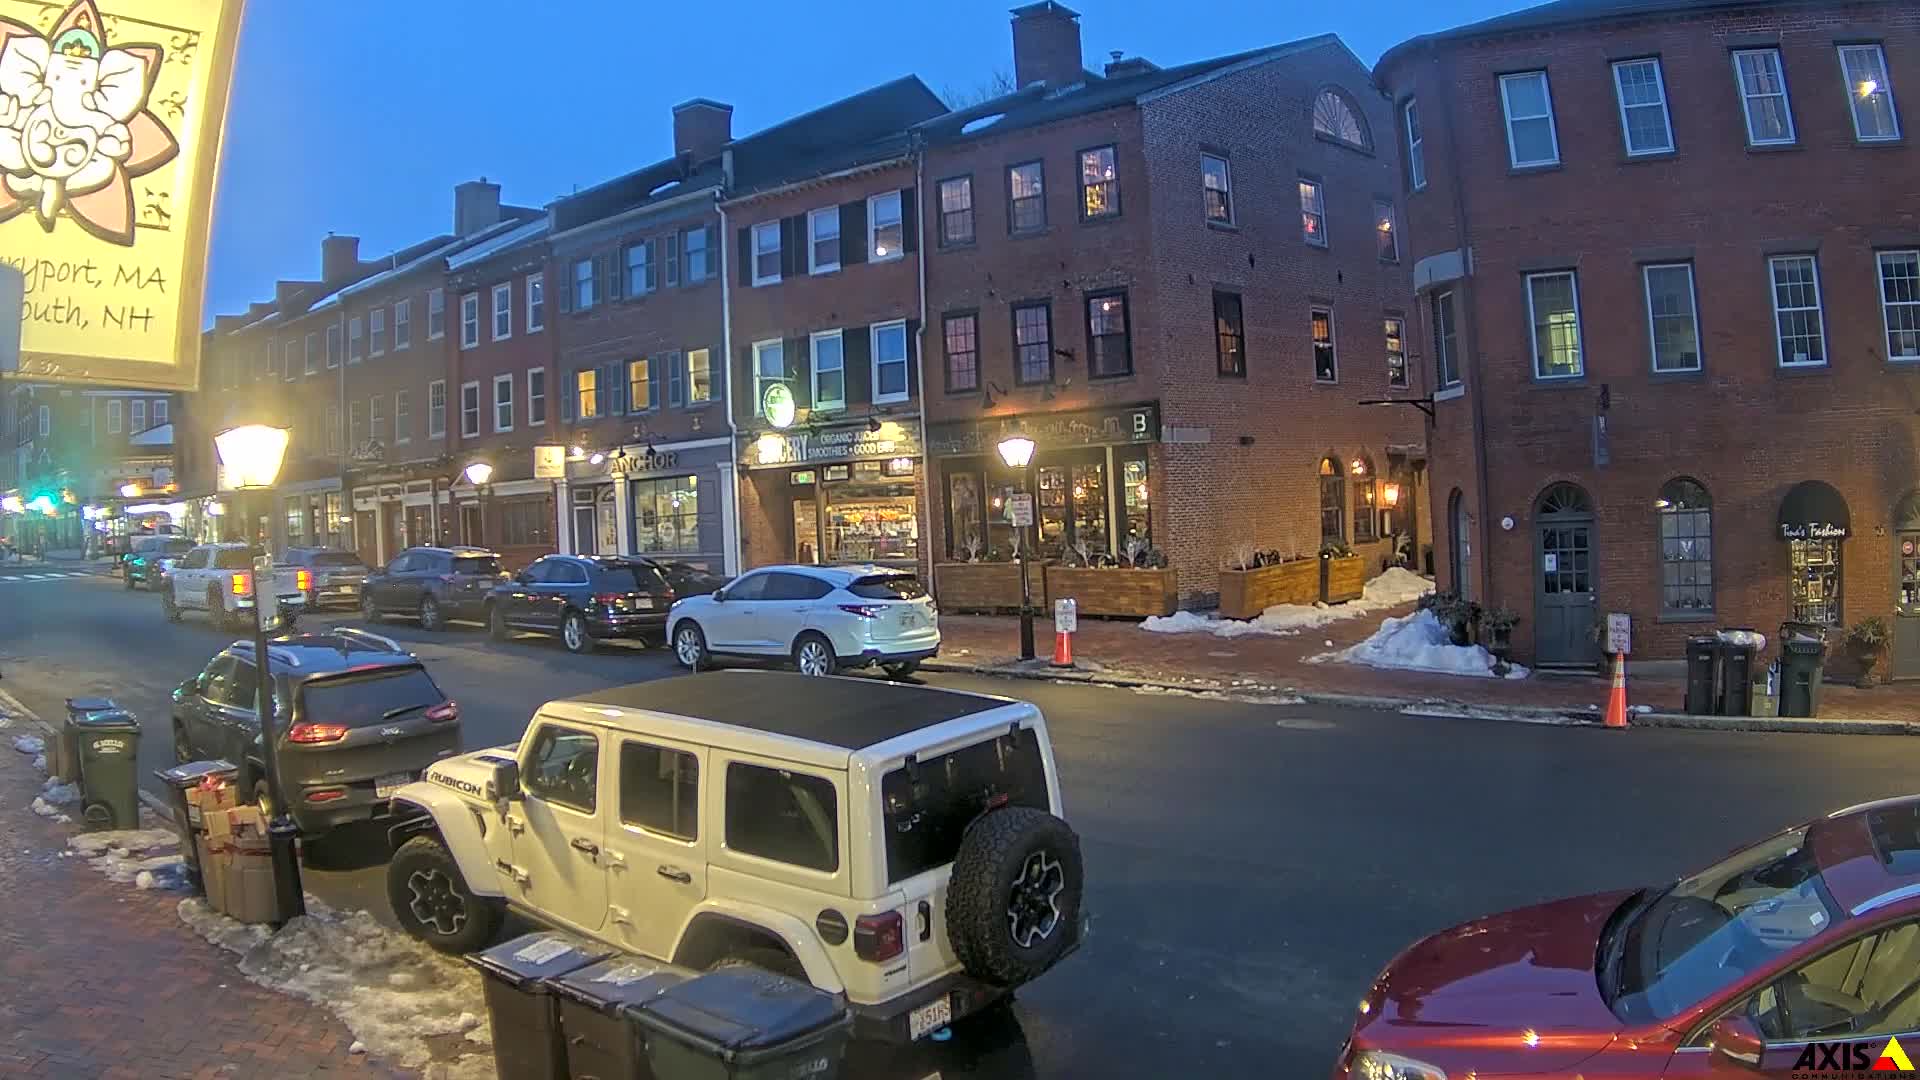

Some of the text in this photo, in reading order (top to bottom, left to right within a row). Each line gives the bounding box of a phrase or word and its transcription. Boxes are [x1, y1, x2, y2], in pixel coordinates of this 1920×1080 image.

[114, 264, 166, 294] MA
[103, 305, 154, 333] NH
[1132, 413, 1147, 433] B
[853, 443, 877, 455] GOOD
[611, 451, 680, 473] ANCHOR
[430, 771, 482, 796] RUBICON
